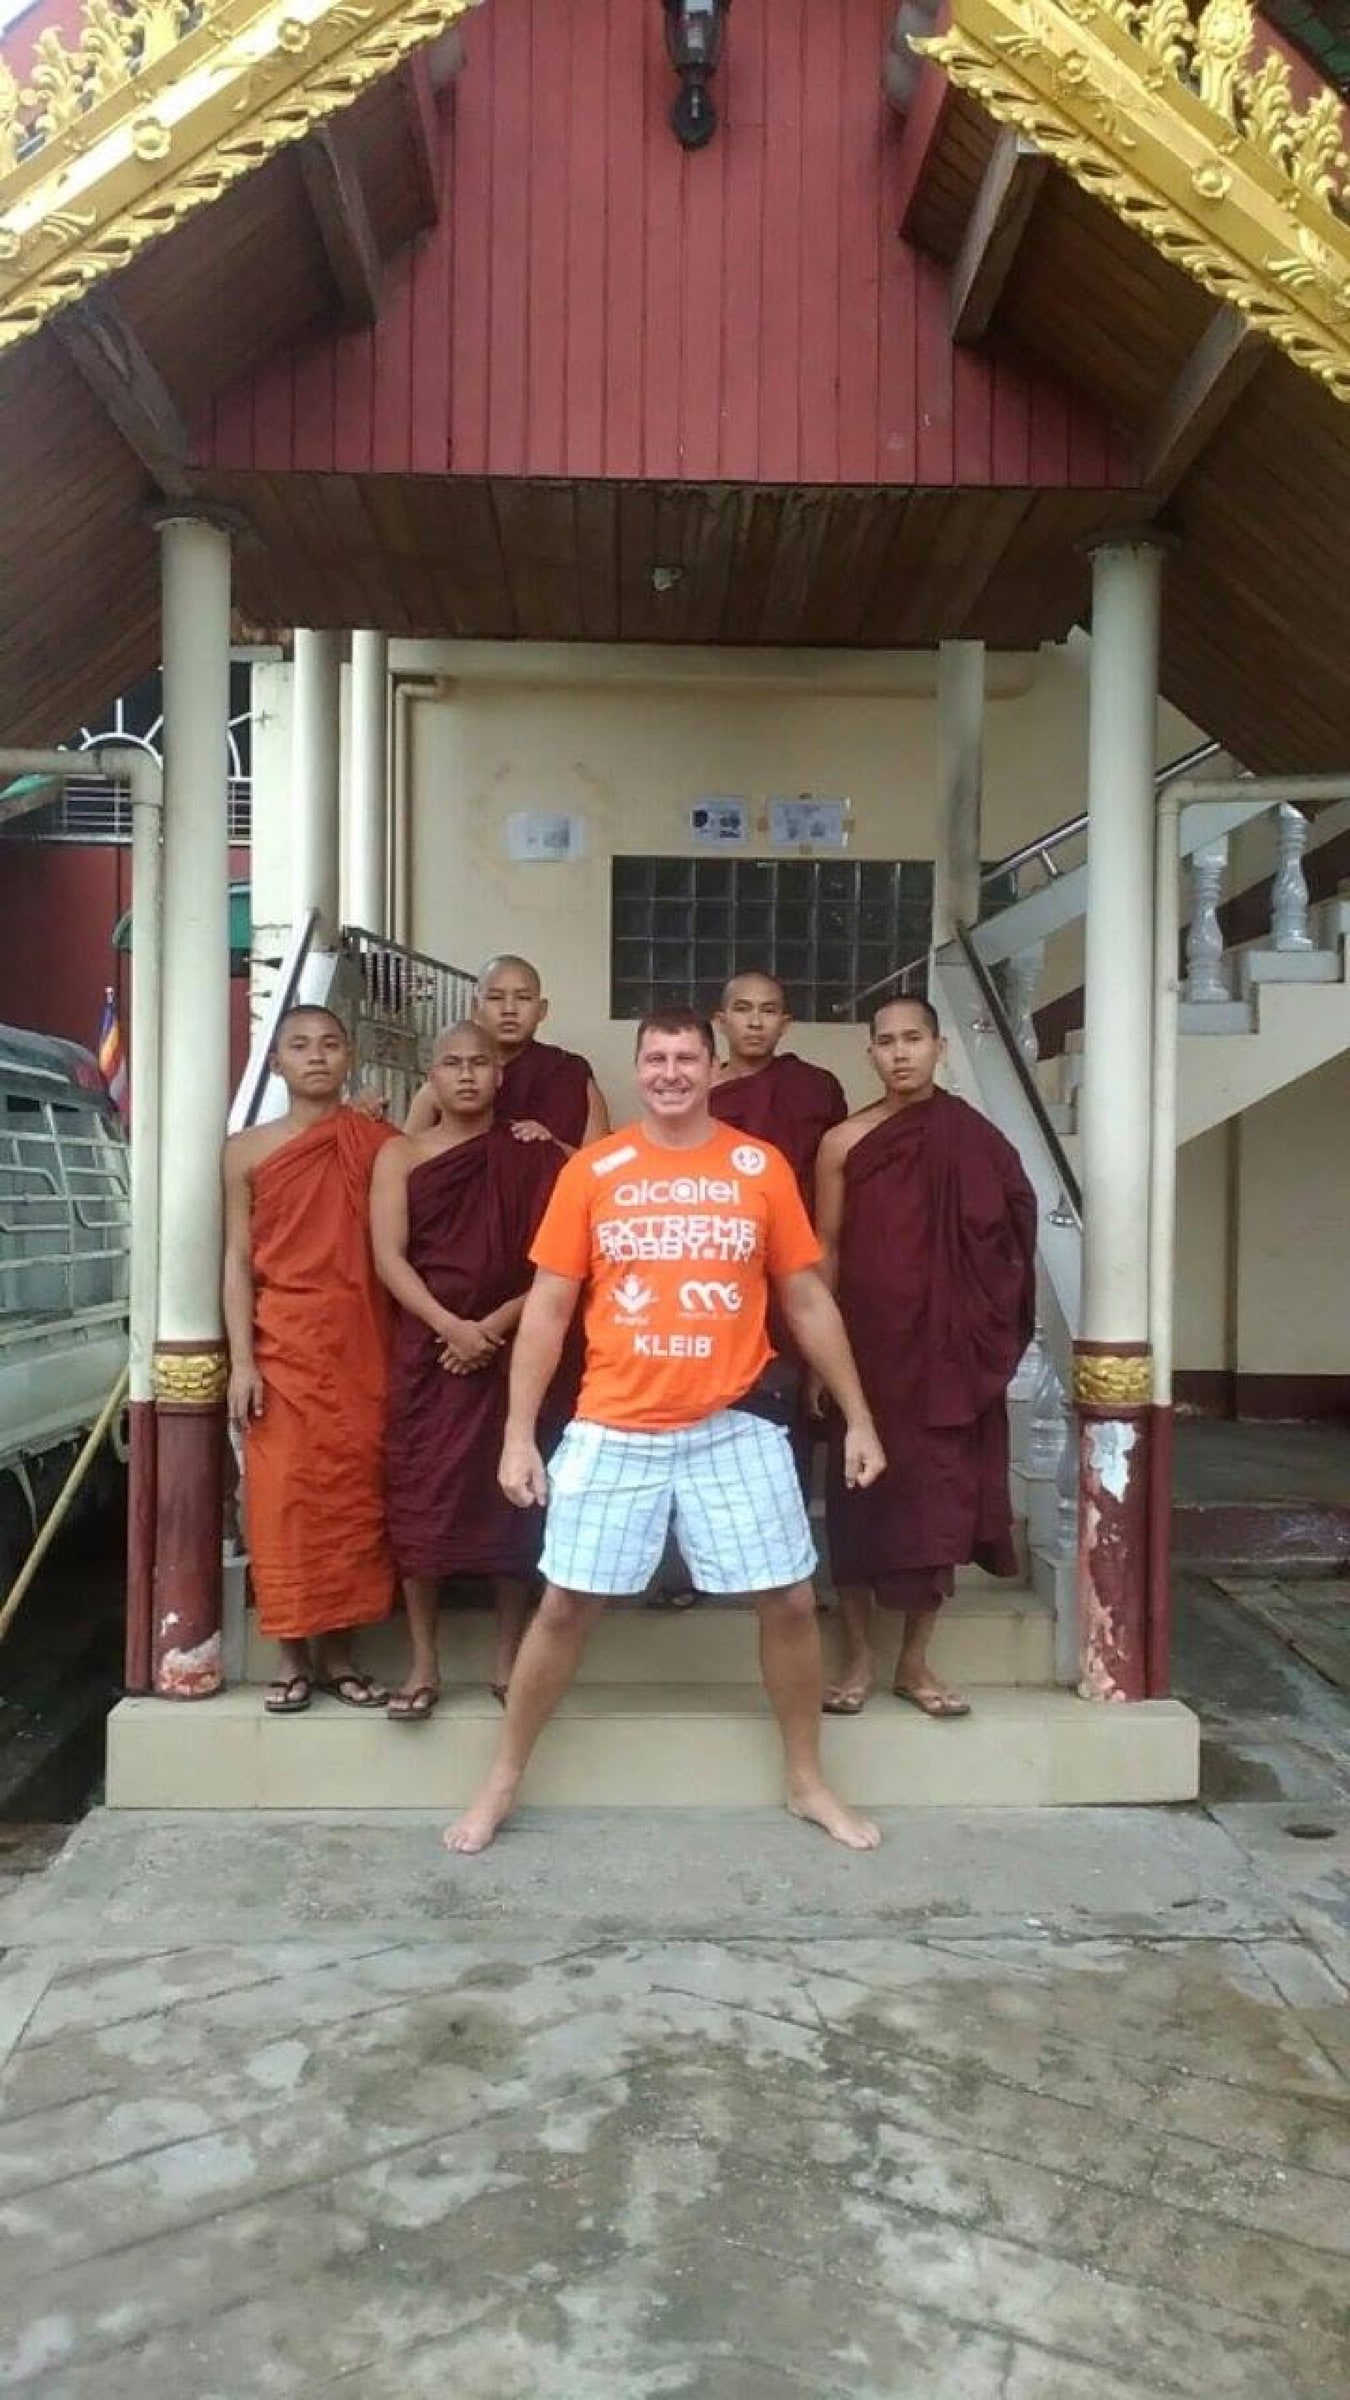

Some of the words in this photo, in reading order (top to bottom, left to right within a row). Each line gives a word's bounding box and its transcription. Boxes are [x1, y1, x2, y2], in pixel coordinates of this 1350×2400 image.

[613, 1177, 740, 1206] alcatel
[597, 1214, 757, 1243] EXTREME
[632, 1334, 713, 1358] KLEIB
